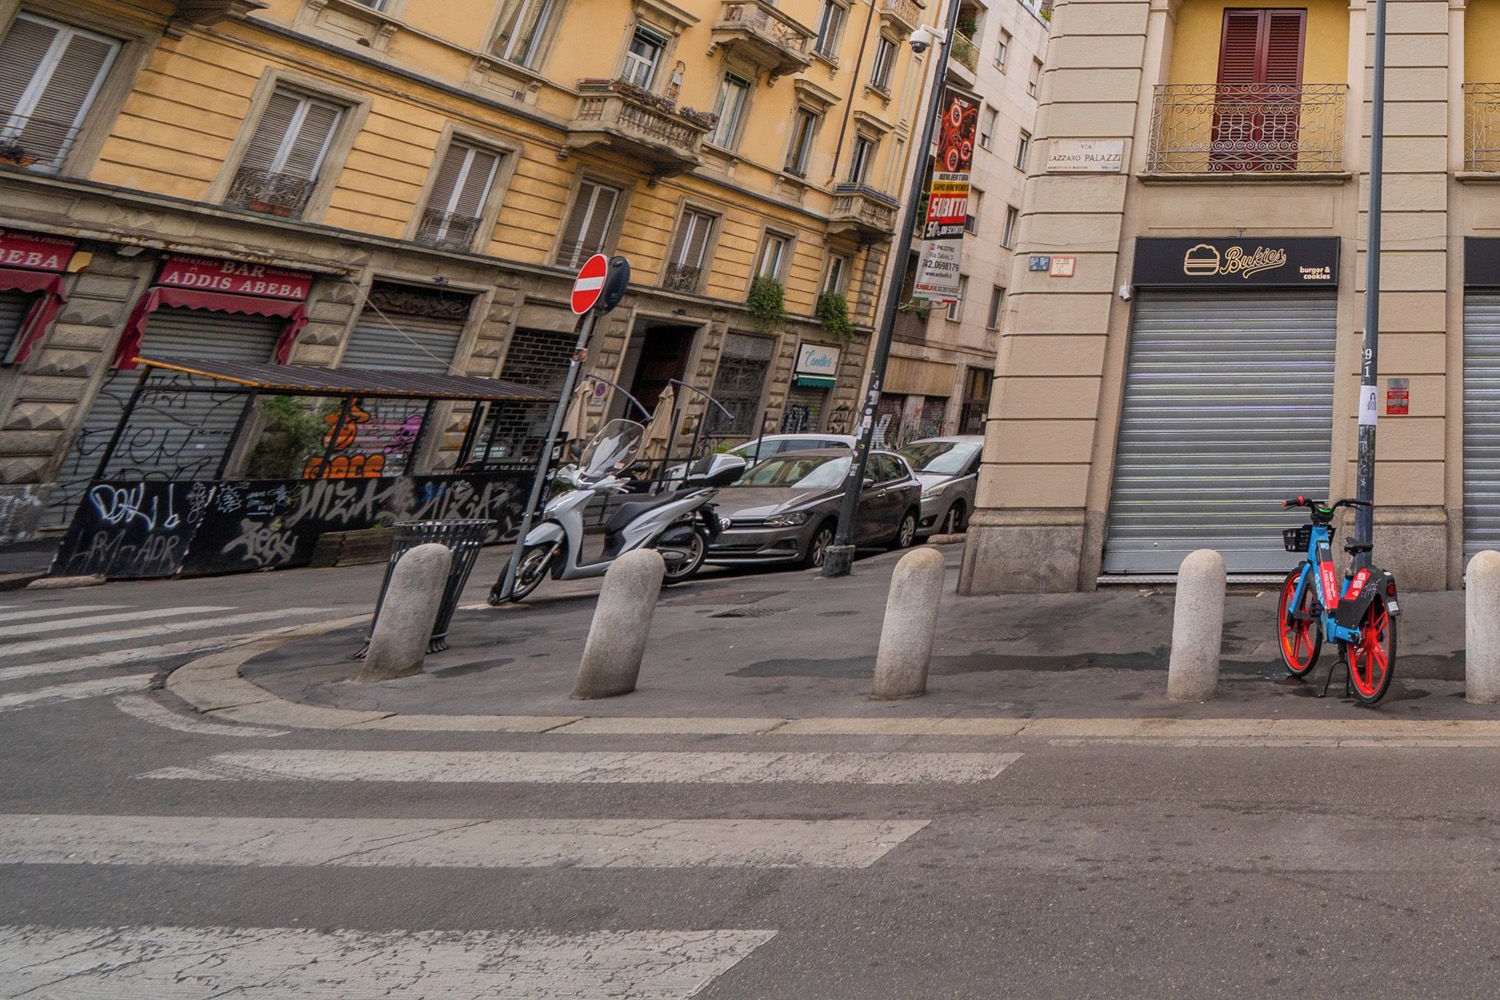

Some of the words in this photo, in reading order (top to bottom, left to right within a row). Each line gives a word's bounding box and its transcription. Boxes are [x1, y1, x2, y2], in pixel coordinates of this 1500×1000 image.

[1084, 153, 1121, 162] PALAZZI
[220, 260, 267, 278] BAR
[1219, 246, 1287, 279] Bukies
[1300, 266, 1324, 274] burger
[165, 271, 233, 290] ADDIS
[239, 280, 303, 298] ABEBA
